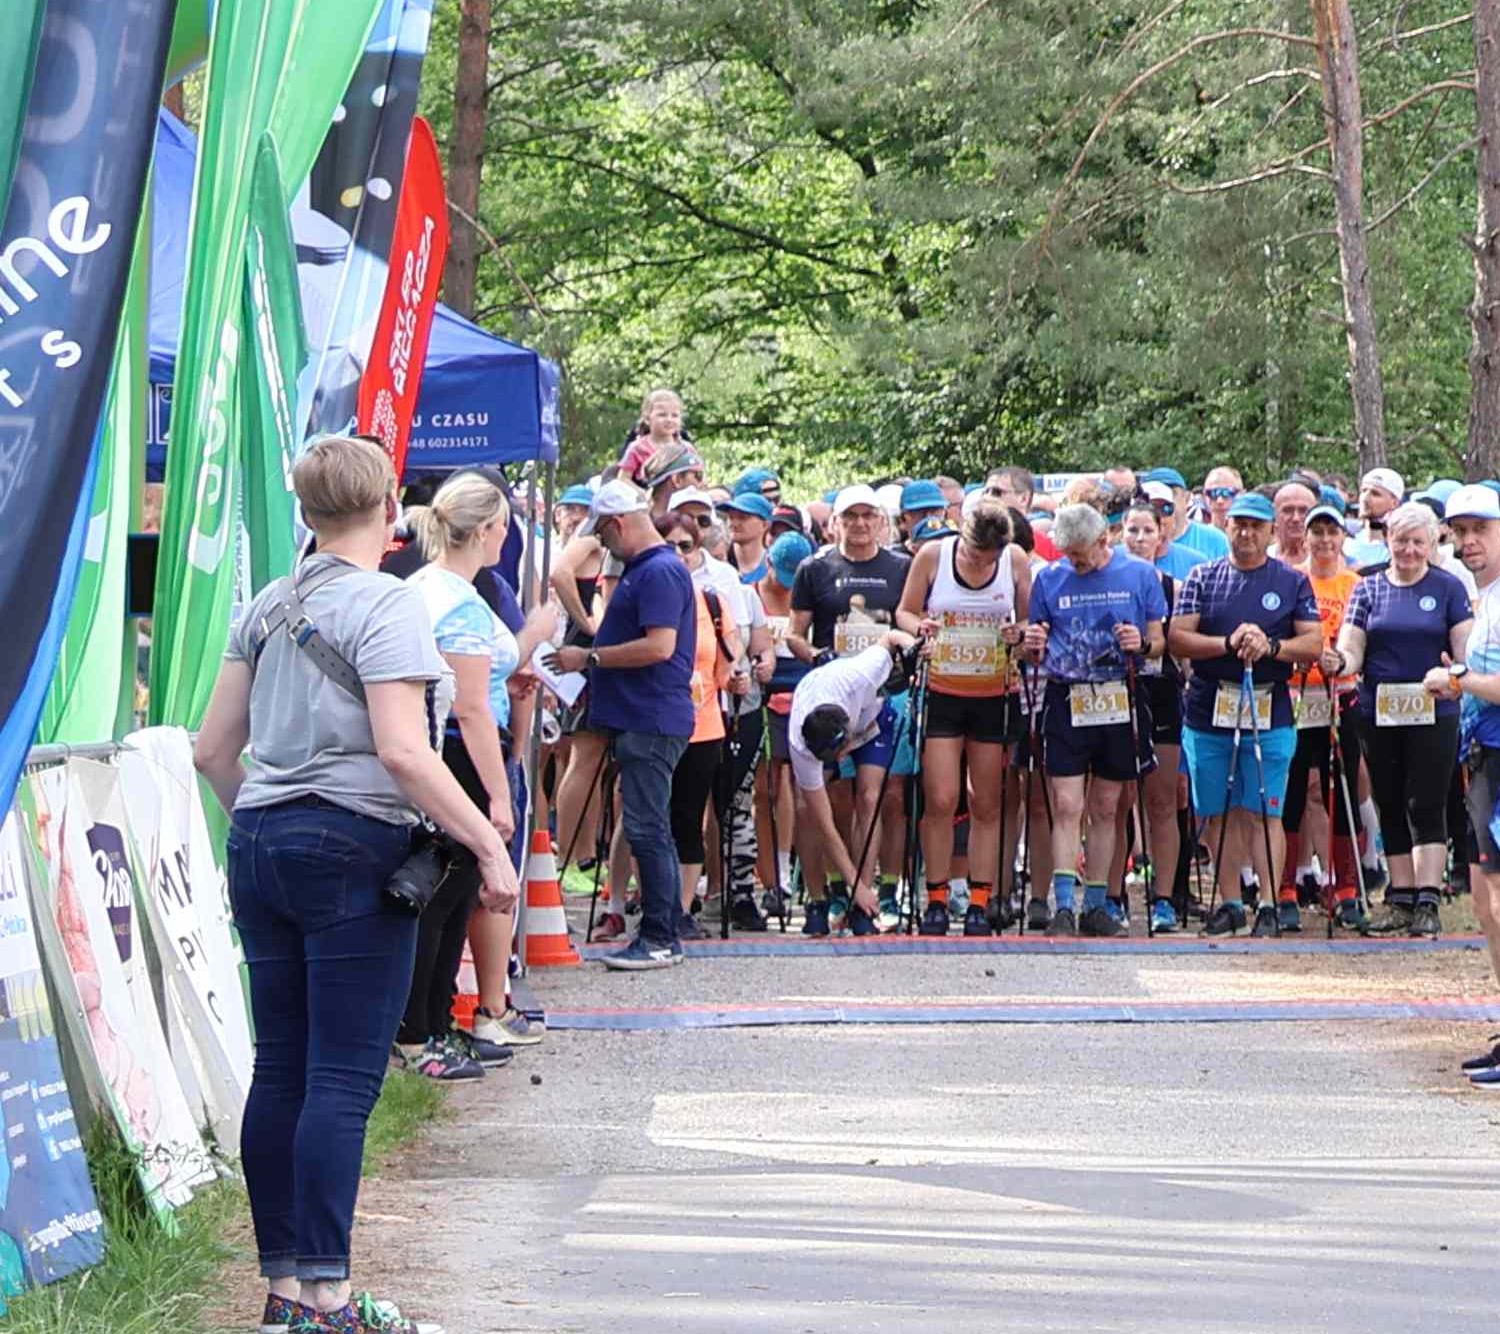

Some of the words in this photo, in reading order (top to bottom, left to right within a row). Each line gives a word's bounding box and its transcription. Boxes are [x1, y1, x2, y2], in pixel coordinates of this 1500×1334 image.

[431, 412, 489, 428] CZASU
[428, 435, 489, 449] 602314171
[949, 646, 988, 662] 359
[1082, 695, 1119, 713] 361
[1387, 696, 1425, 714] 370
